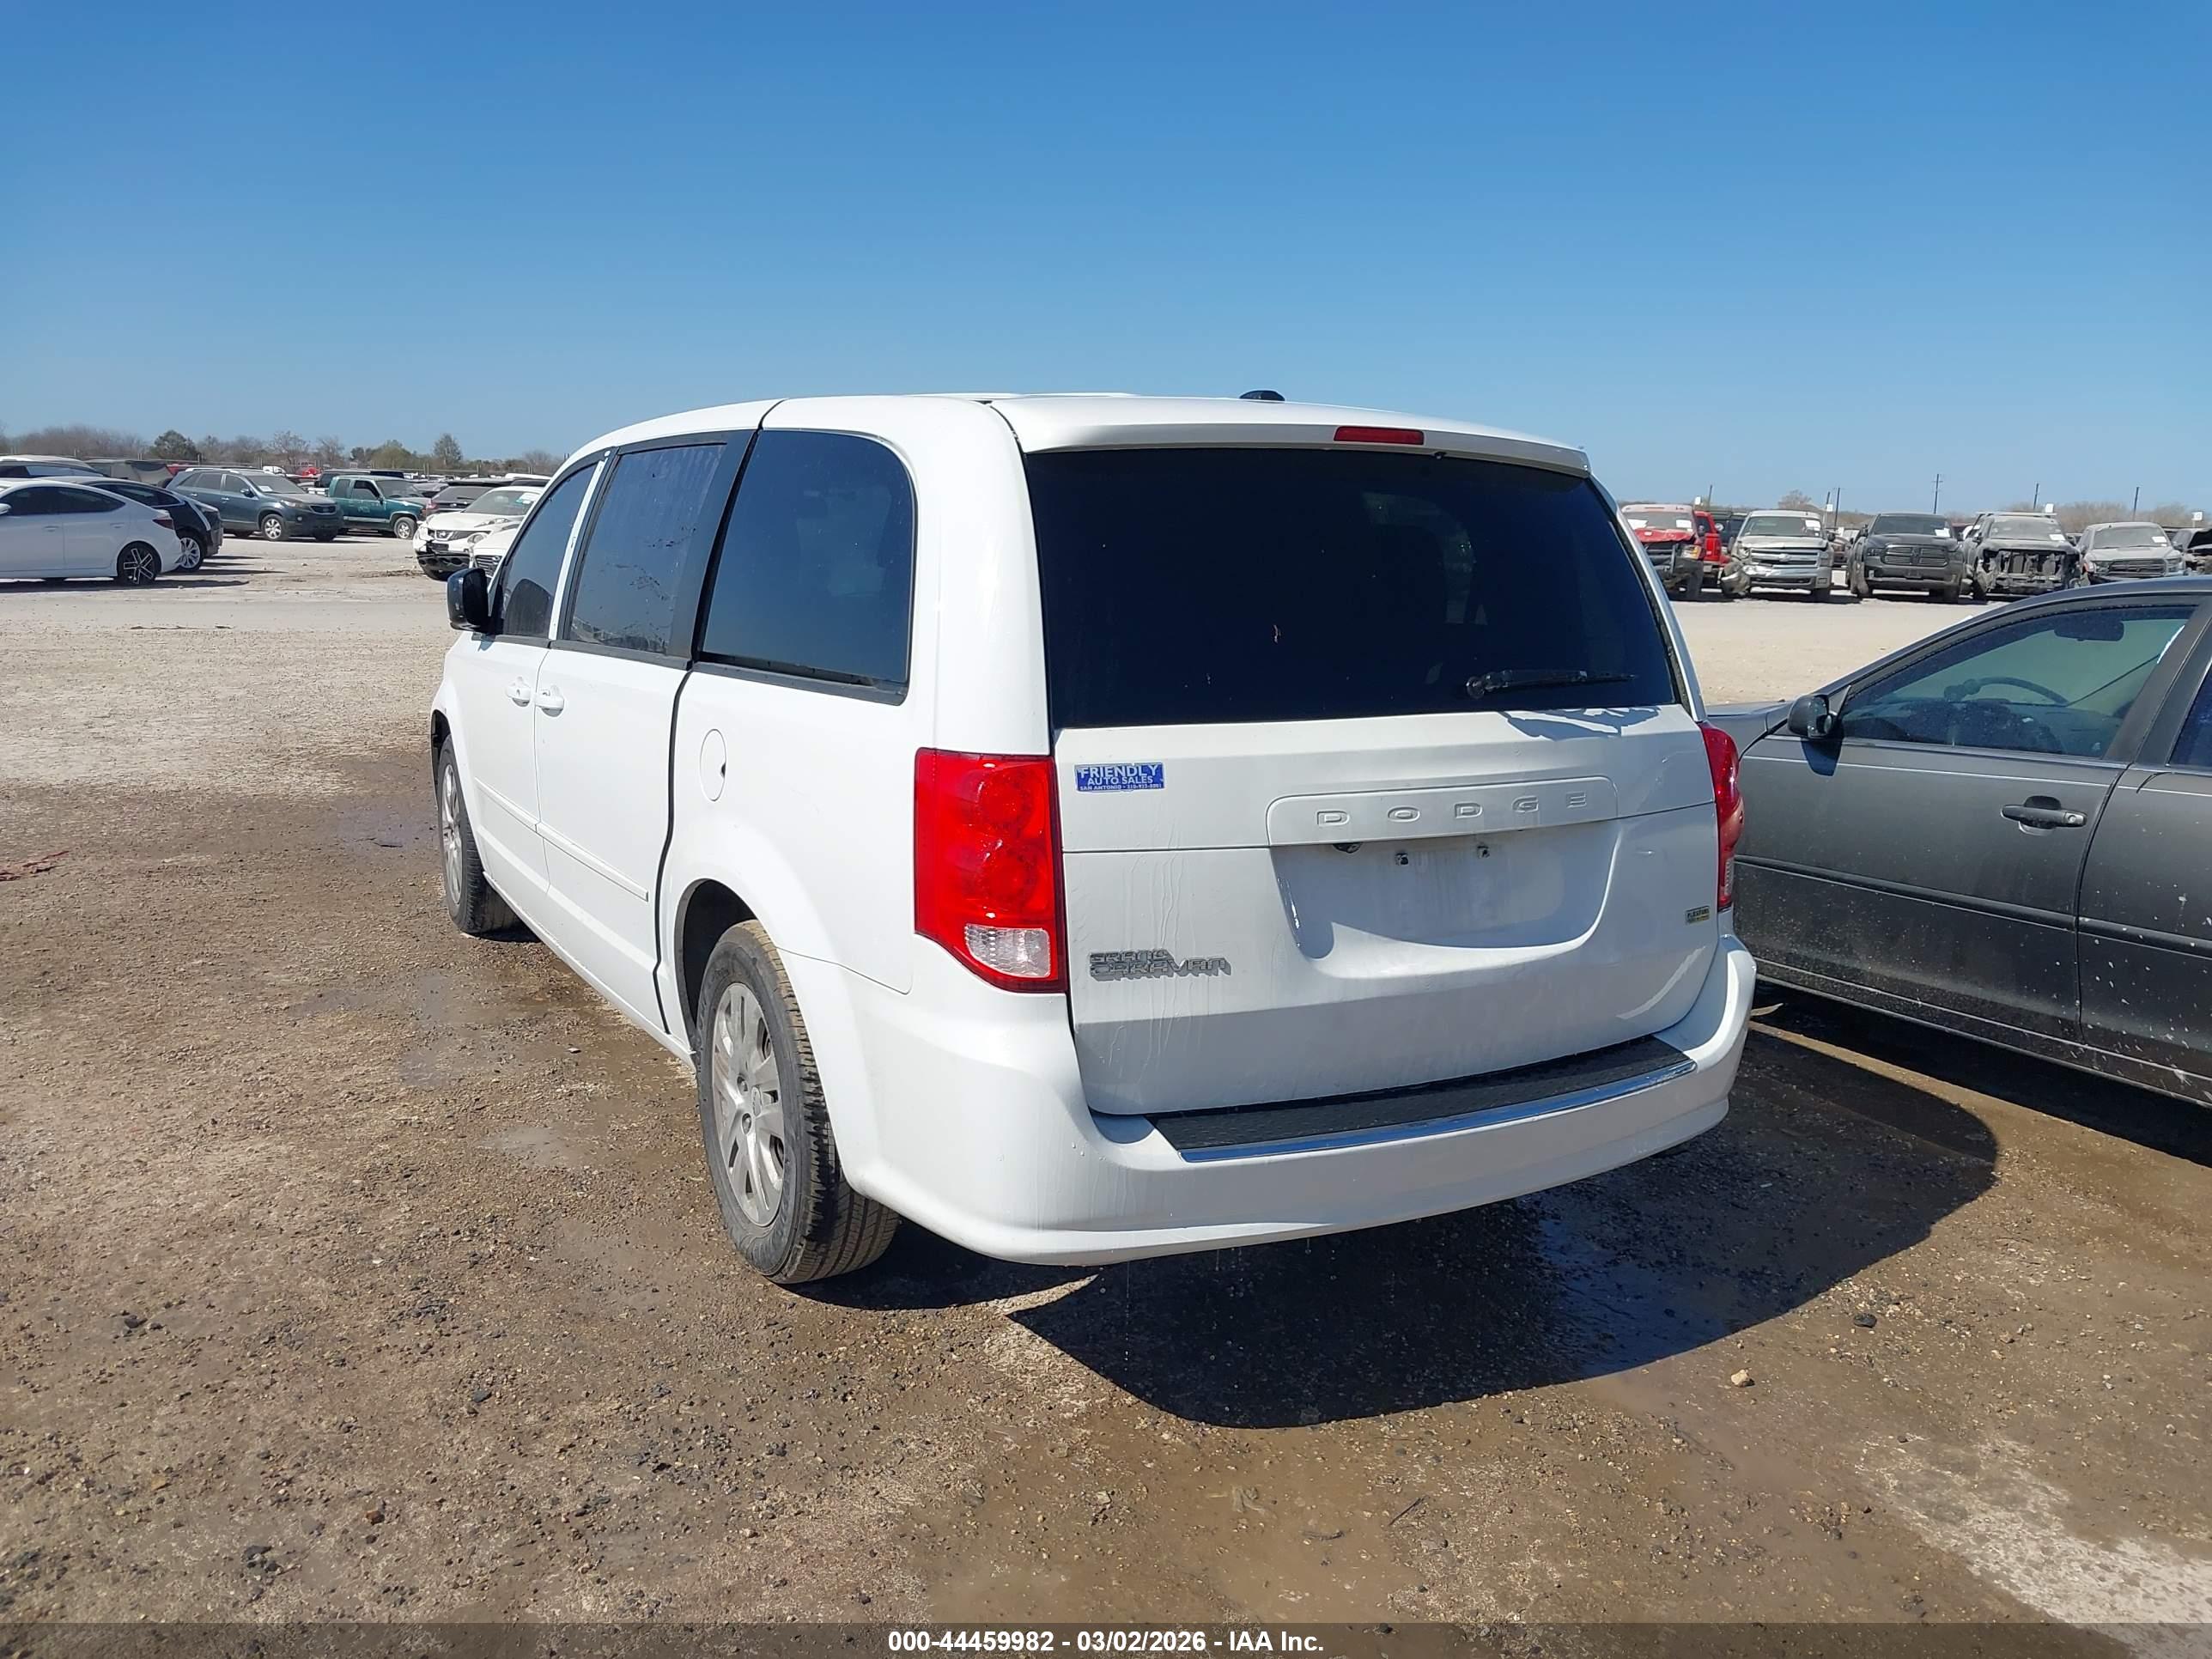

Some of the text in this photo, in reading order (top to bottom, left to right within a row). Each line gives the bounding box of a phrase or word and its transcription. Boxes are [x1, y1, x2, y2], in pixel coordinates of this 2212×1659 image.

[1079, 764, 1158, 779] FRIENDLY
[1087, 775, 1153, 786] AUTO SALES
[1316, 790, 1588, 826] DODGE
